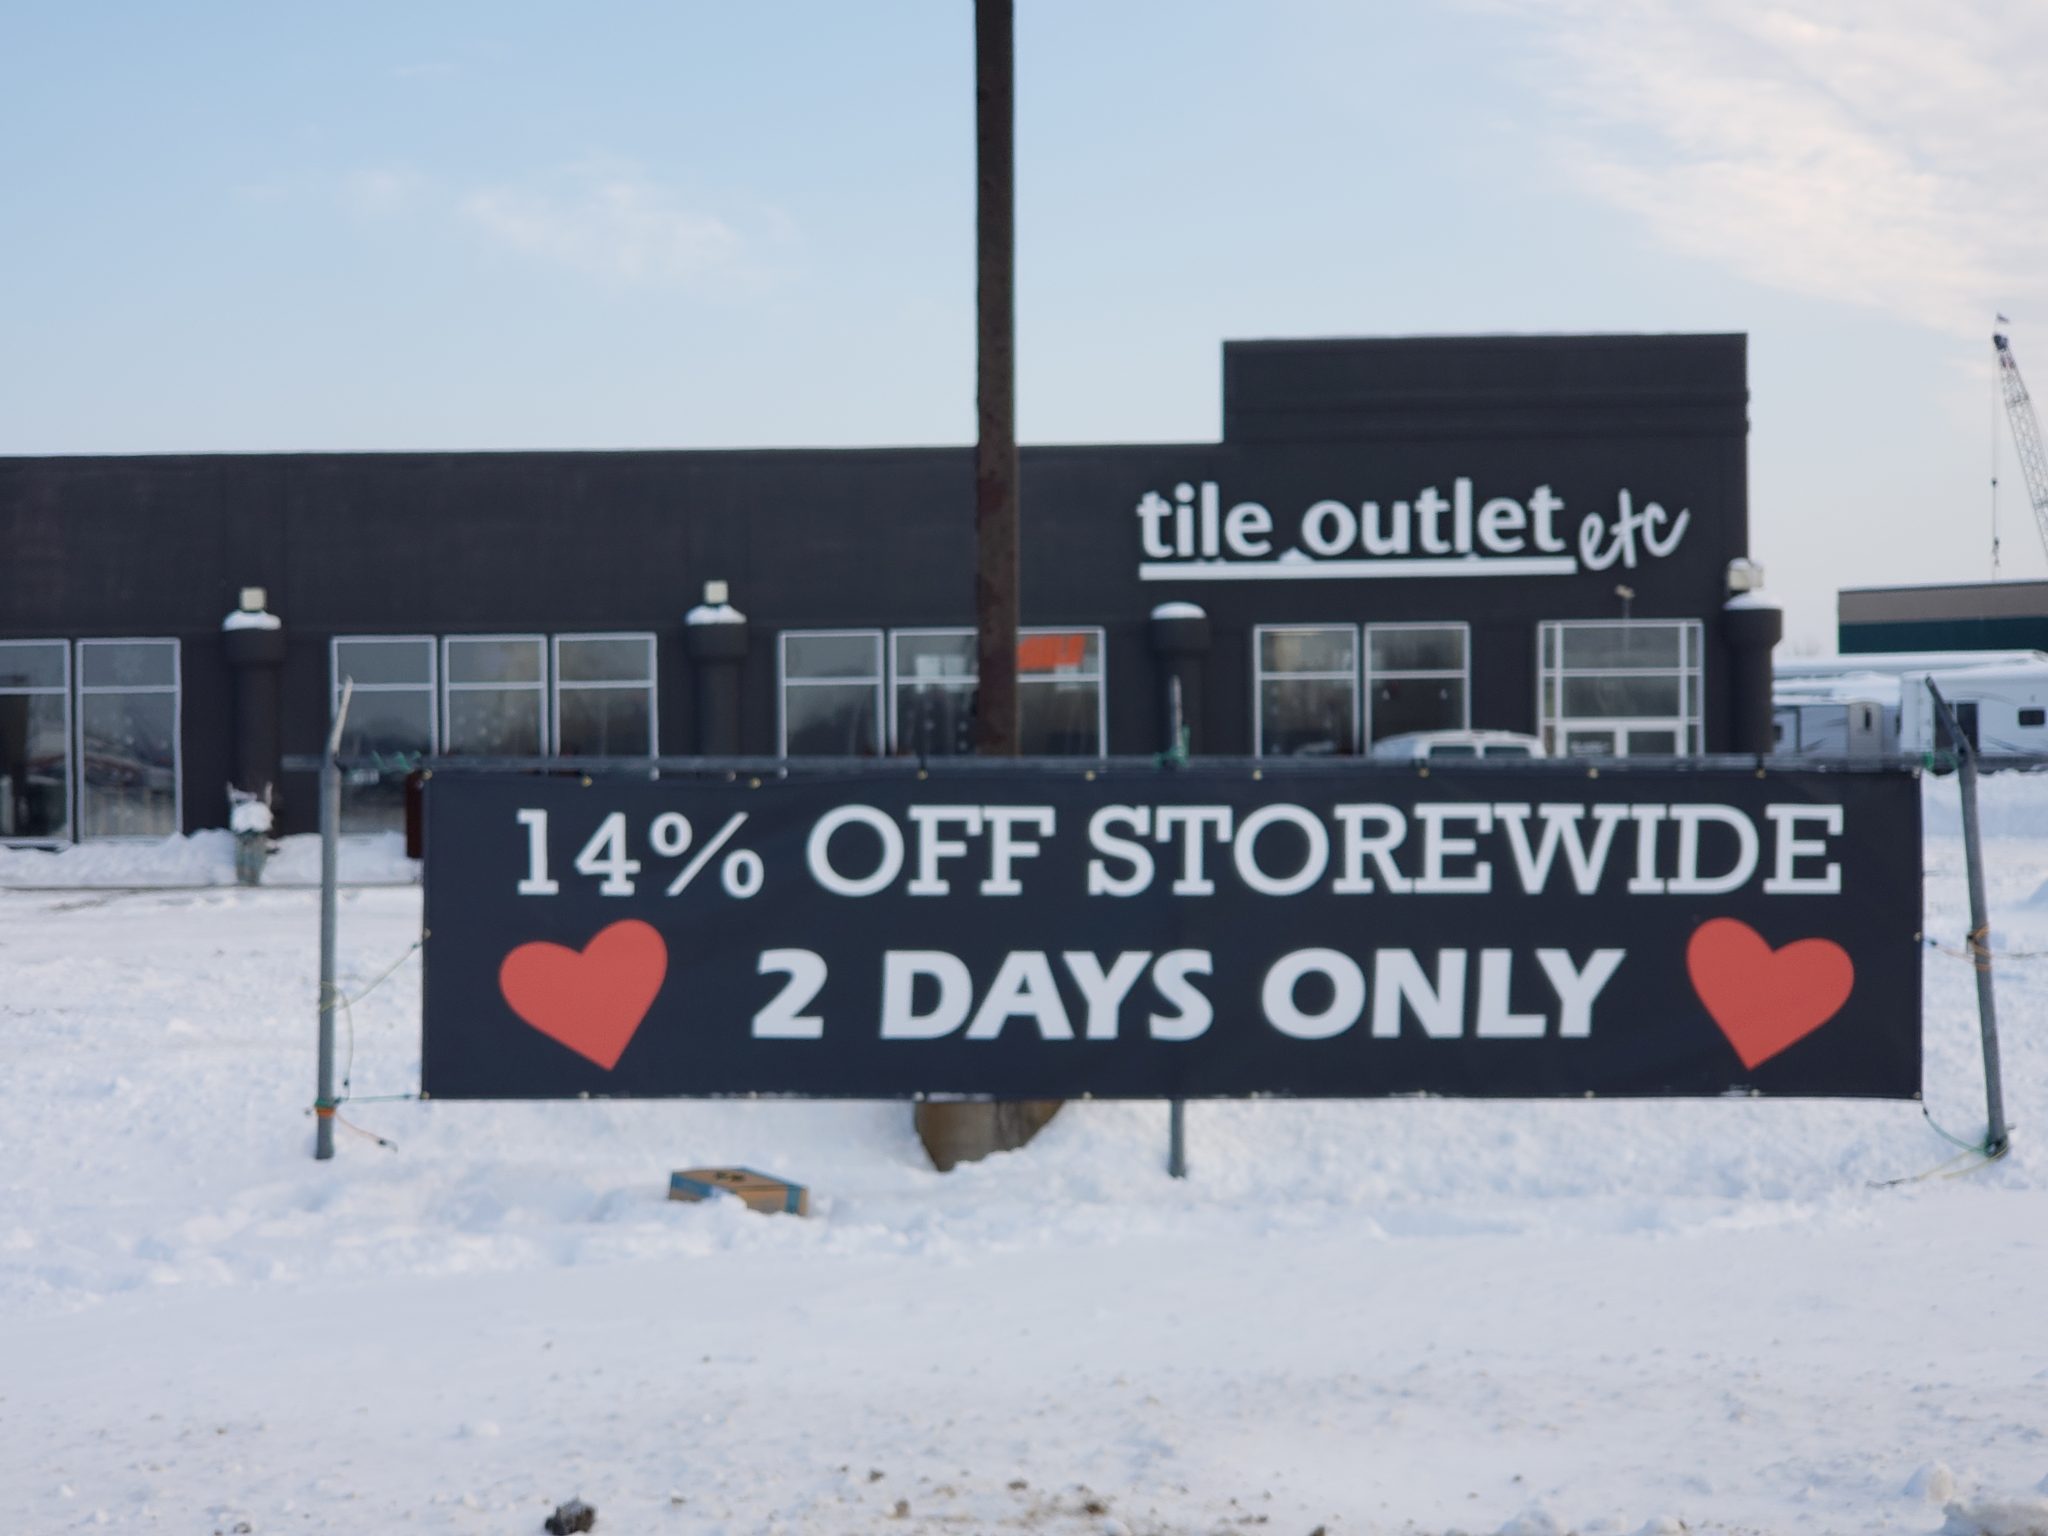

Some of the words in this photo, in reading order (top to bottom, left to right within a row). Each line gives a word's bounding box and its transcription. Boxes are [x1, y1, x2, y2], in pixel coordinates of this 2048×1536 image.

[1136, 481, 1272, 558] tile
[1302, 477, 1565, 556] outlet
[1579, 488, 1690, 572] etc
[516, 808, 765, 899] 14%
[806, 803, 1056, 898] OFF
[1087, 802, 1844, 898] STOREWIDE
[751, 947, 826, 1040] 2
[880, 948, 1214, 1042] DAYS
[1261, 947, 1625, 1040] ONLY
